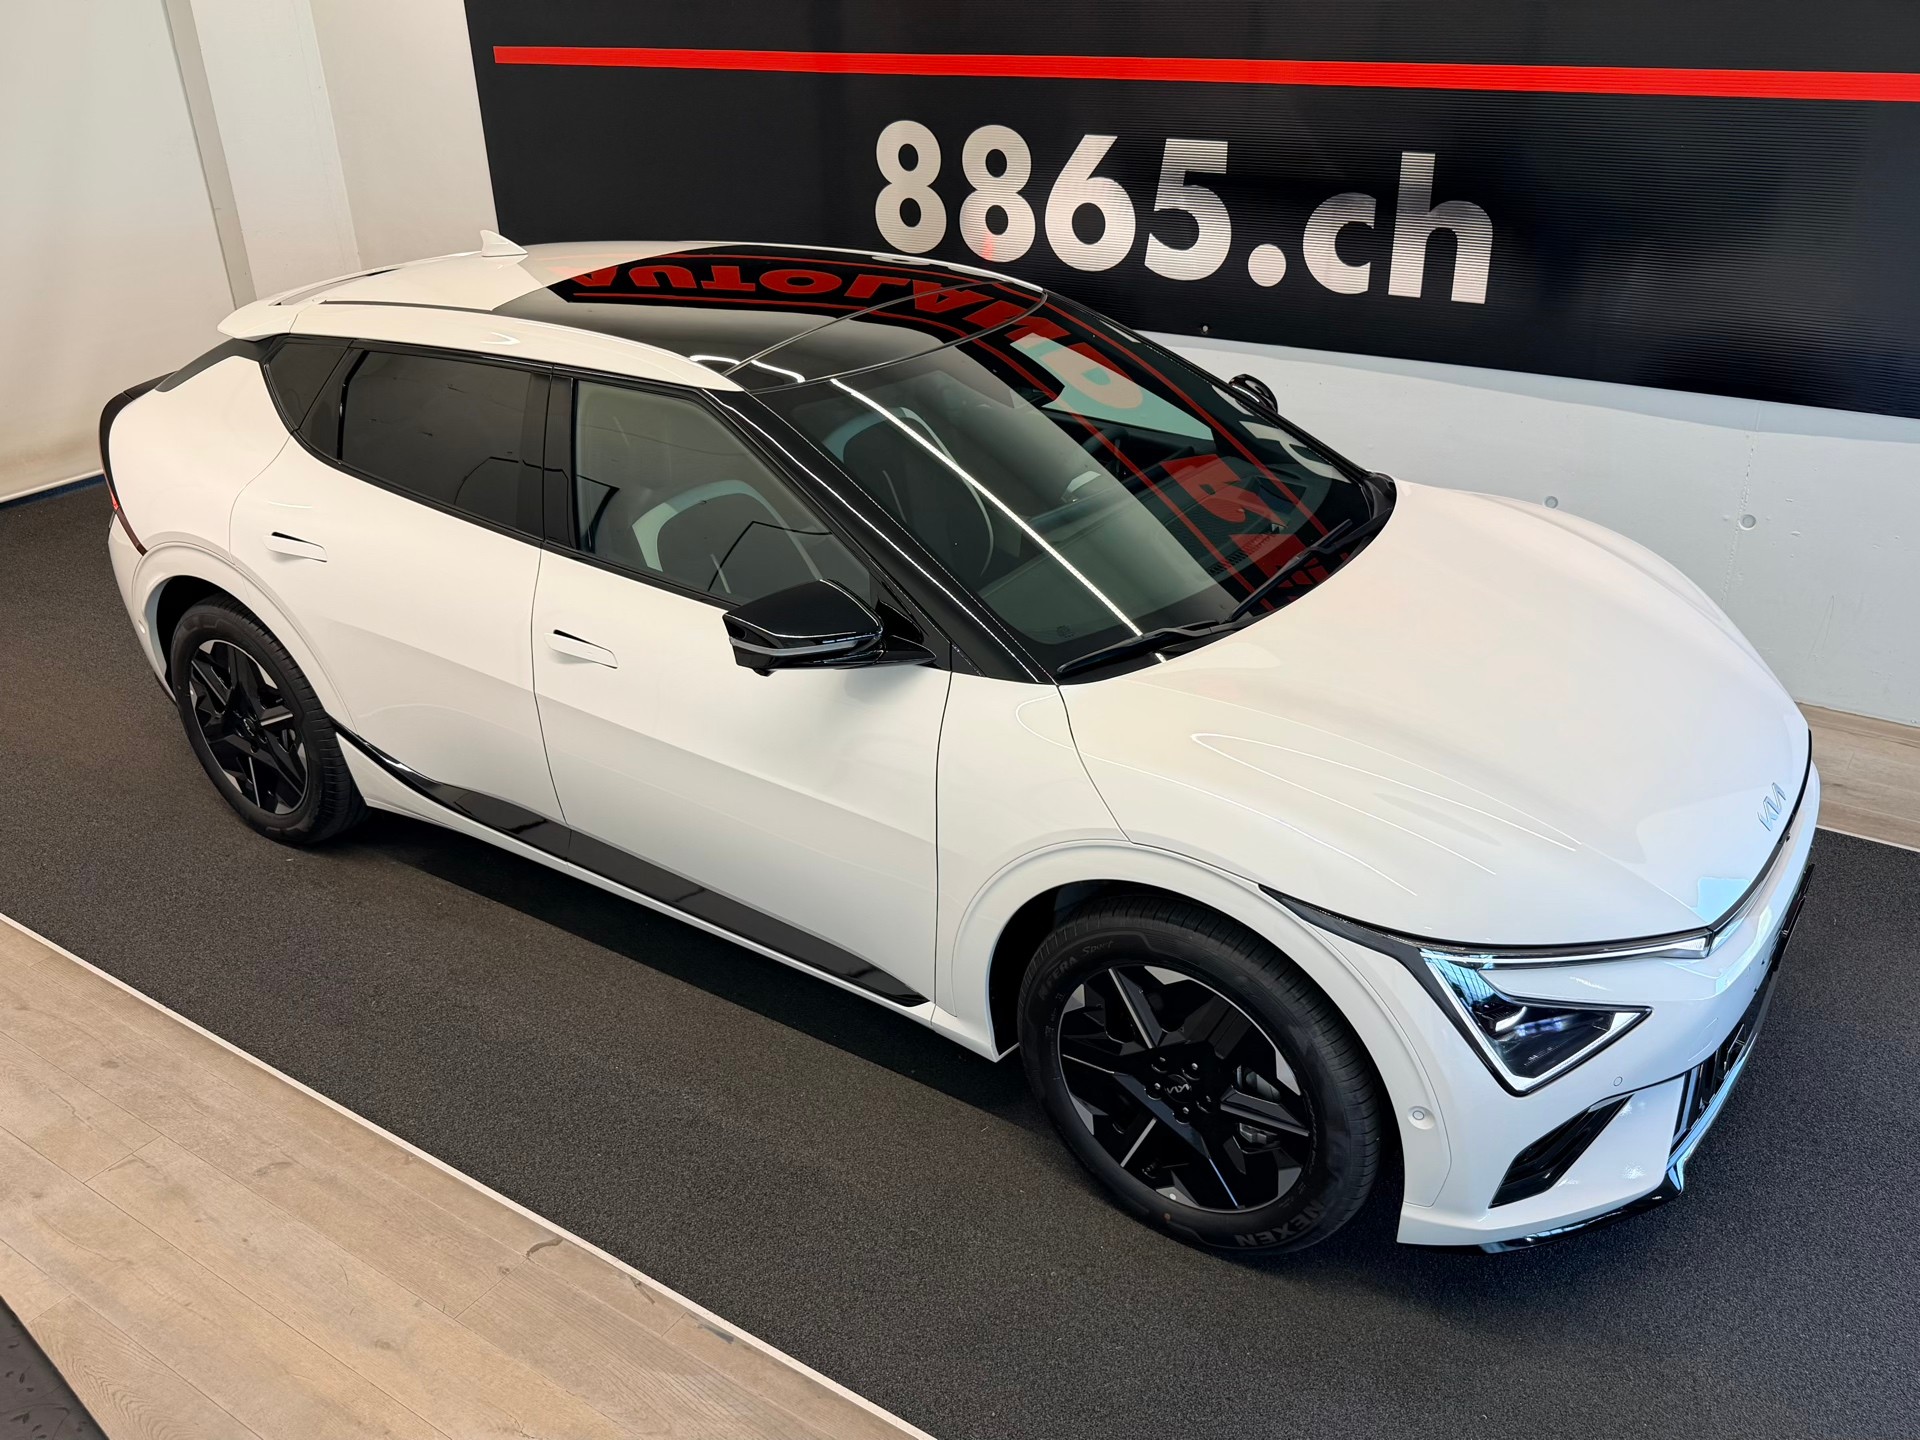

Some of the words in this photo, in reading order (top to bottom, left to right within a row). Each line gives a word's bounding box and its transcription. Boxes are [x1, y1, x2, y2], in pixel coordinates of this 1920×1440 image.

[875, 119, 1494, 305] 8865.ch
[1757, 782, 1787, 832] KIA
[1234, 1199, 1325, 1247] NEXEN
